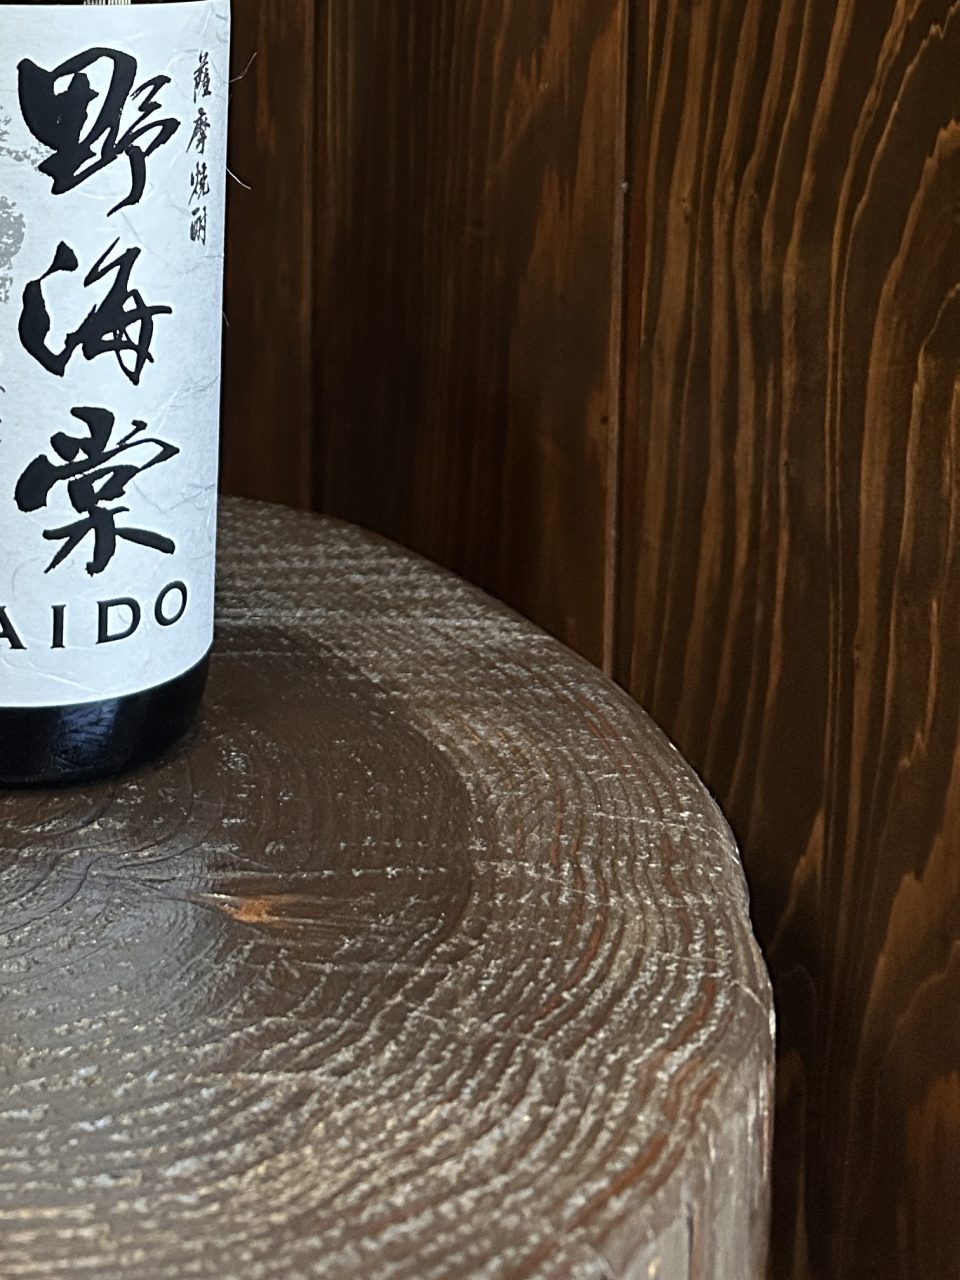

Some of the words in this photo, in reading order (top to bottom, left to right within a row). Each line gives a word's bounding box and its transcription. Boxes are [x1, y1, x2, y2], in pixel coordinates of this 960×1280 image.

[15, 47, 180, 577] 野海棠
[186, 51, 212, 246] 薩摩焼酎
